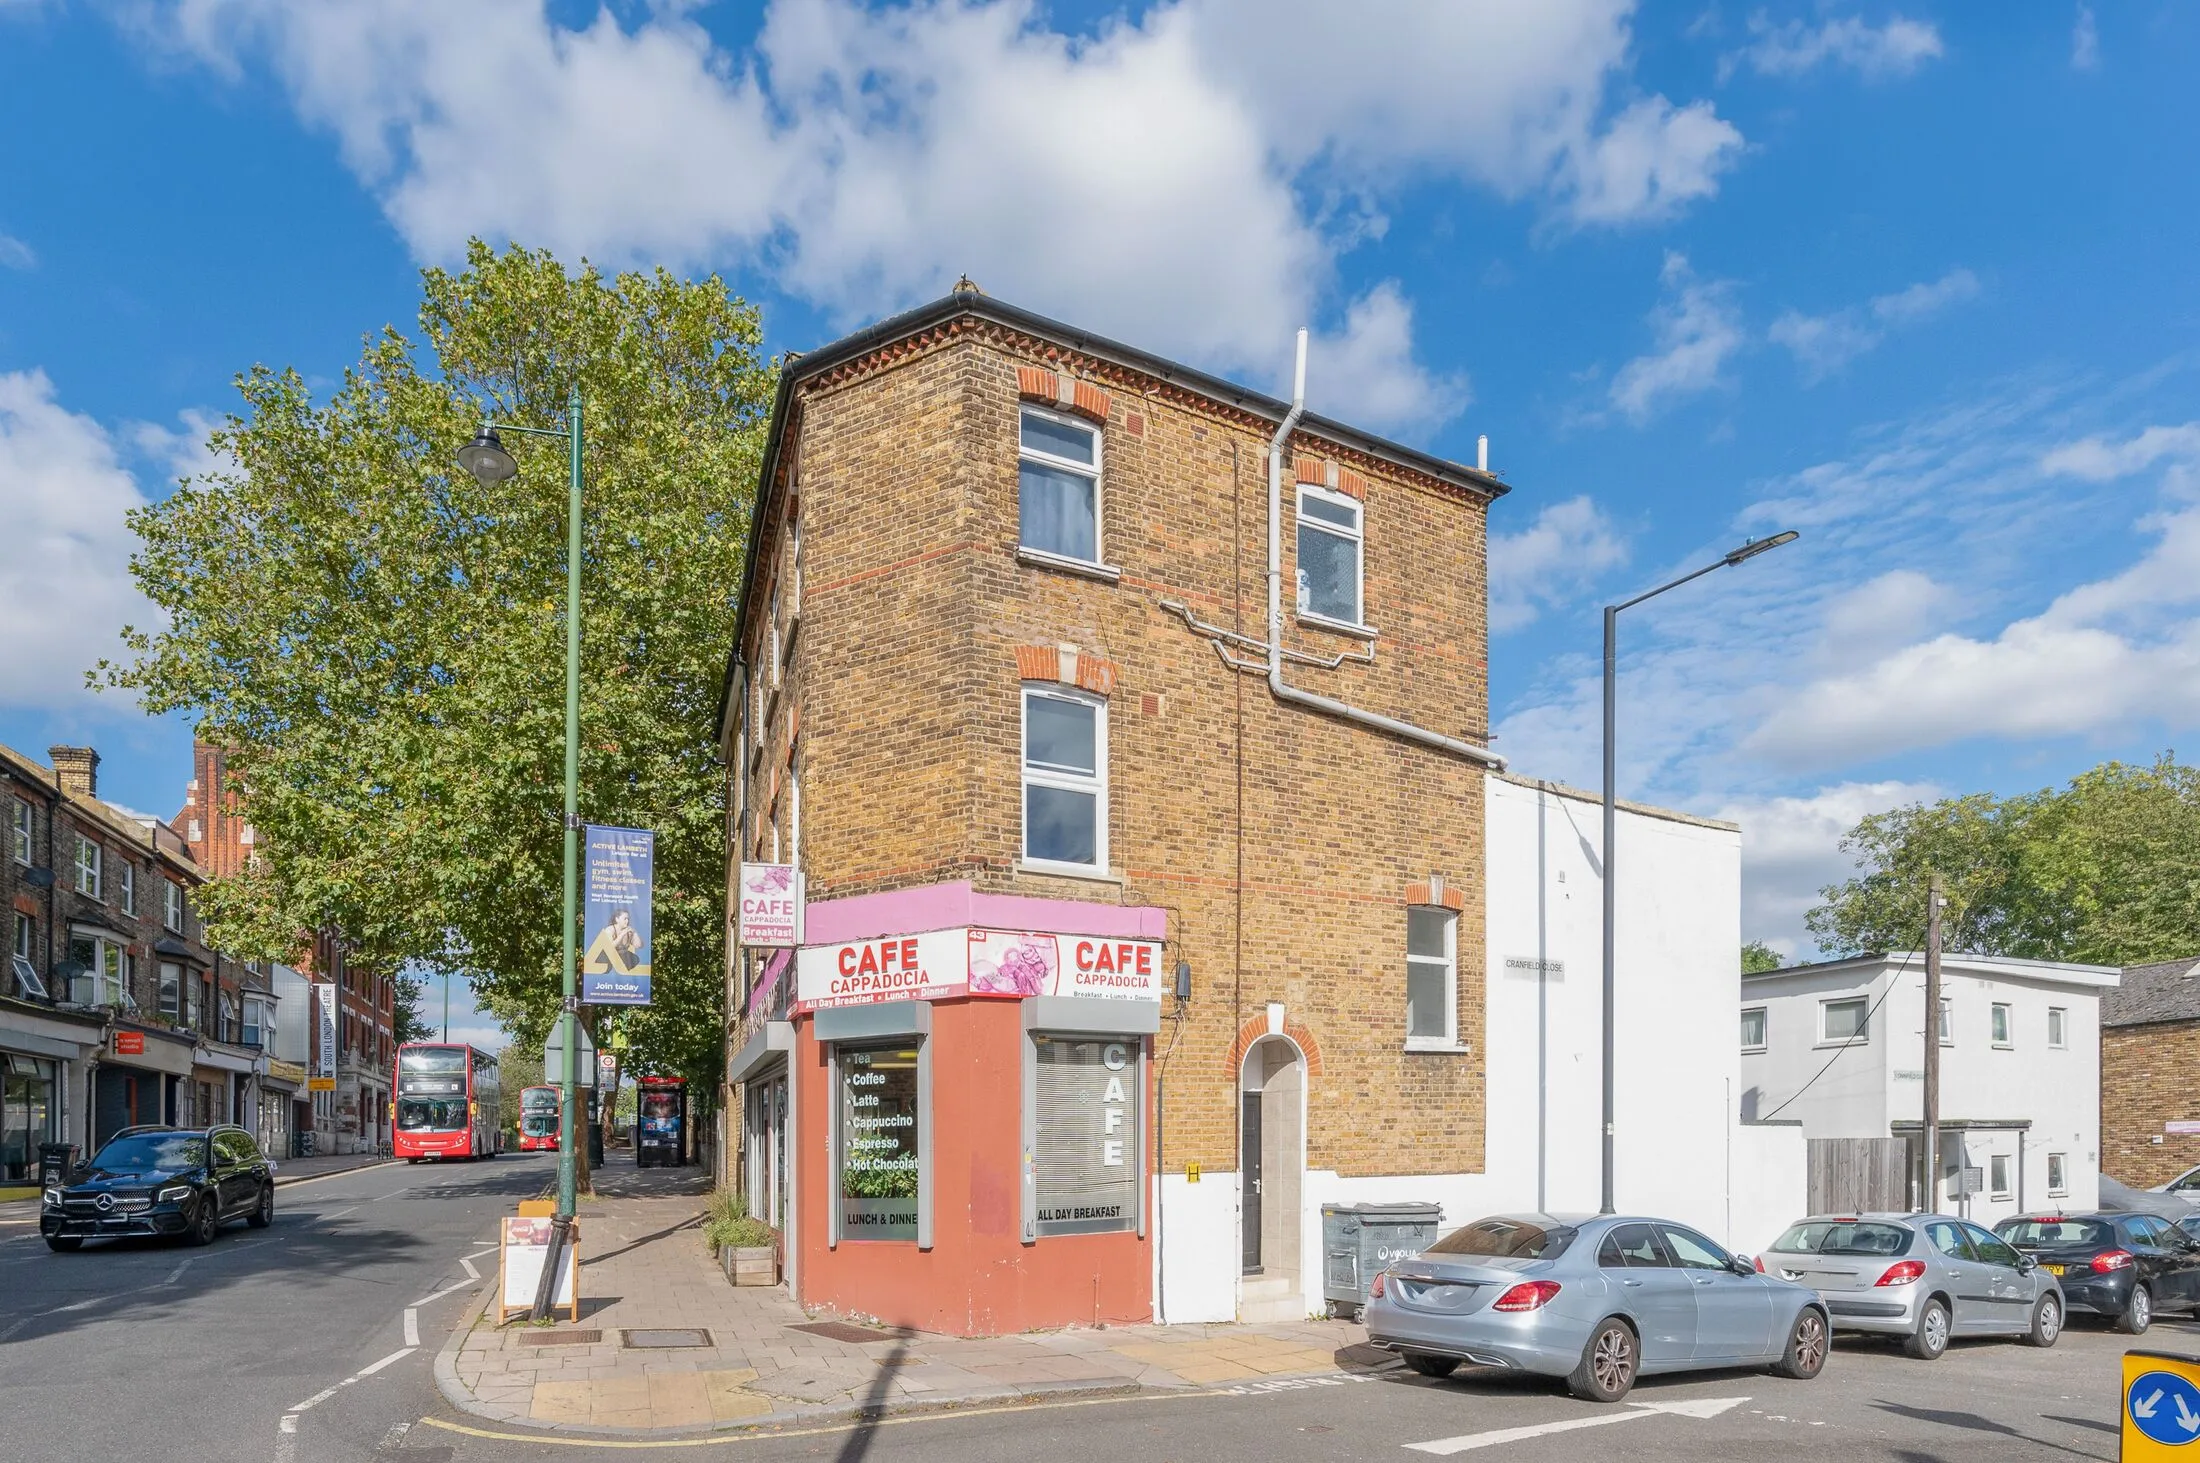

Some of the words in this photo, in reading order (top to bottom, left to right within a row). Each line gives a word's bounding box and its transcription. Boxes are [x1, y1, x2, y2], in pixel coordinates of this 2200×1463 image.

[617, 844, 648, 852] LAMBETH
[592, 860, 629, 868] Unlimited
[619, 877, 645, 885] classes
[743, 899, 793, 915] CAFE
[744, 927, 793, 937] Breakfast
[968, 931, 985, 940] 43
[838, 938, 919, 977] CAFE
[1076, 941, 1152, 975] CAFE
[1505, 959, 1540, 970] CRANFIELD
[1542, 962, 1563, 972] CLOSE
[595, 982, 613, 990] Join
[615, 983, 639, 992] today
[831, 970, 929, 994] CAPPADOCIA
[1076, 973, 1149, 988] CAPPADOCIA
[323, 988, 332, 1016] THEATRE
[805, 999, 817, 1009] All
[819, 998, 833, 1008] Day
[835, 995, 874, 1006] Breakfast
[885, 990, 910, 1000] Lunch
[921, 987, 950, 997] Dinner
[1073, 991, 1103, 999] Breakfast
[323, 1017, 332, 1044] LONDON
[324, 1045, 332, 1066] SOUTH
[853, 1053, 871, 1064] Tea
[853, 1073, 886, 1086] Coffee
[853, 1095, 879, 1107] Latte
[1103, 1043, 1126, 1167] CAFE
[853, 1115, 913, 1130] Cappuccino
[853, 1138, 899, 1151] Espresso
[853, 1159, 871, 1171] Hot
[873, 1157, 919, 1171] Chocolat
[1188, 1166, 1198, 1182] H
[847, 1213, 878, 1225] LUNCH
[880, 1213, 887, 1224] &
[889, 1213, 917, 1225] DINNE
[1037, 1208, 1053, 1221] ALL
[1055, 1207, 1072, 1219] DAY
[1074, 1205, 1121, 1219] BREAKFAST
